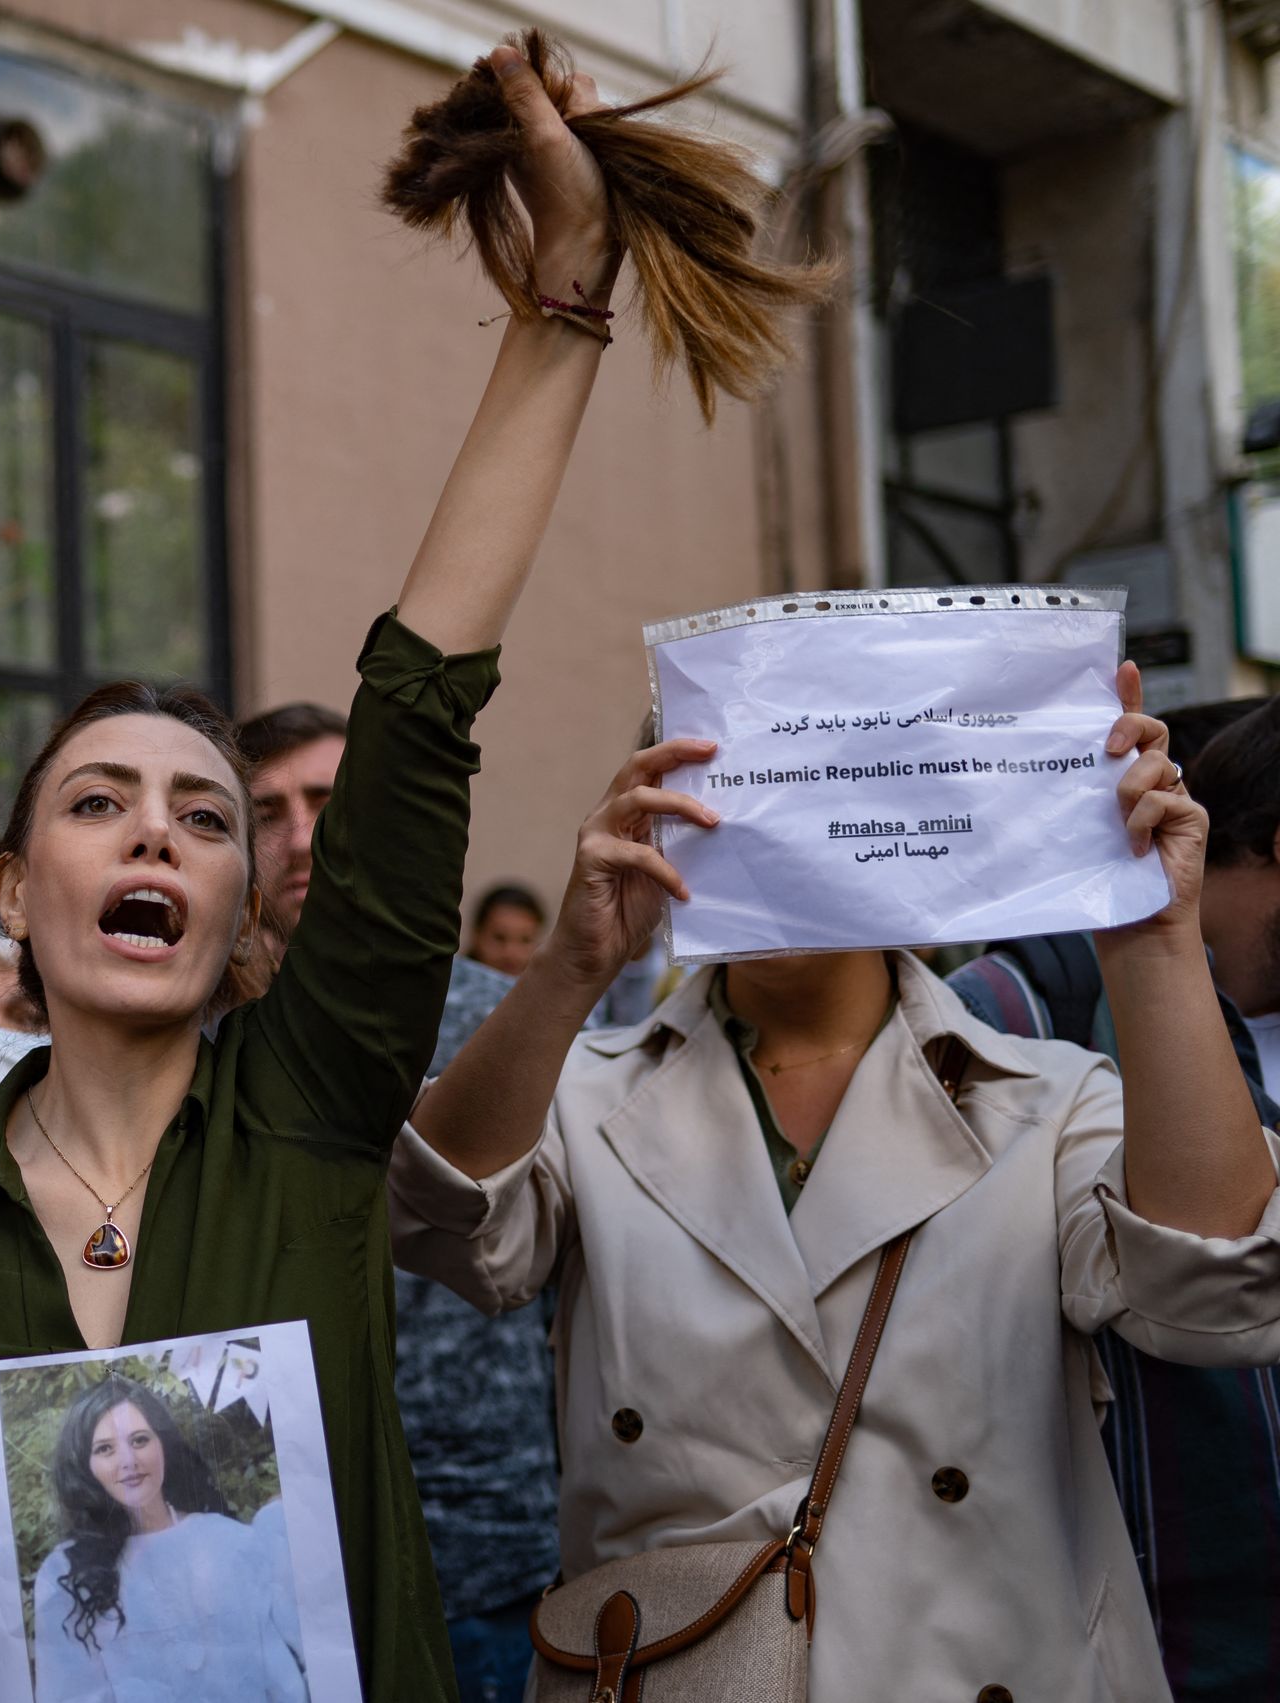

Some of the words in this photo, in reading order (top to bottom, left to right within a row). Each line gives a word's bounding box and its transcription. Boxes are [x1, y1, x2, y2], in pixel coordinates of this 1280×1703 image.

[835, 602, 874, 610] EXXOLITE
[770, 714, 809, 735] گردد
[815, 714, 846, 733] باید
[851, 711, 891, 730] نابود
[897, 708, 953, 728] اسلامی
[957, 710, 1018, 727] جمهوری
[707, 774, 744, 788] The
[749, 766, 820, 785] Islamic
[826, 760, 913, 782] Republic
[919, 758, 968, 774] must
[972, 758, 993, 773] be
[997, 753, 1095, 773] destroyed
[828, 813, 973, 838] #mahsa_amini
[855, 842, 899, 862] امینی
[904, 842, 949, 860] مهسا
